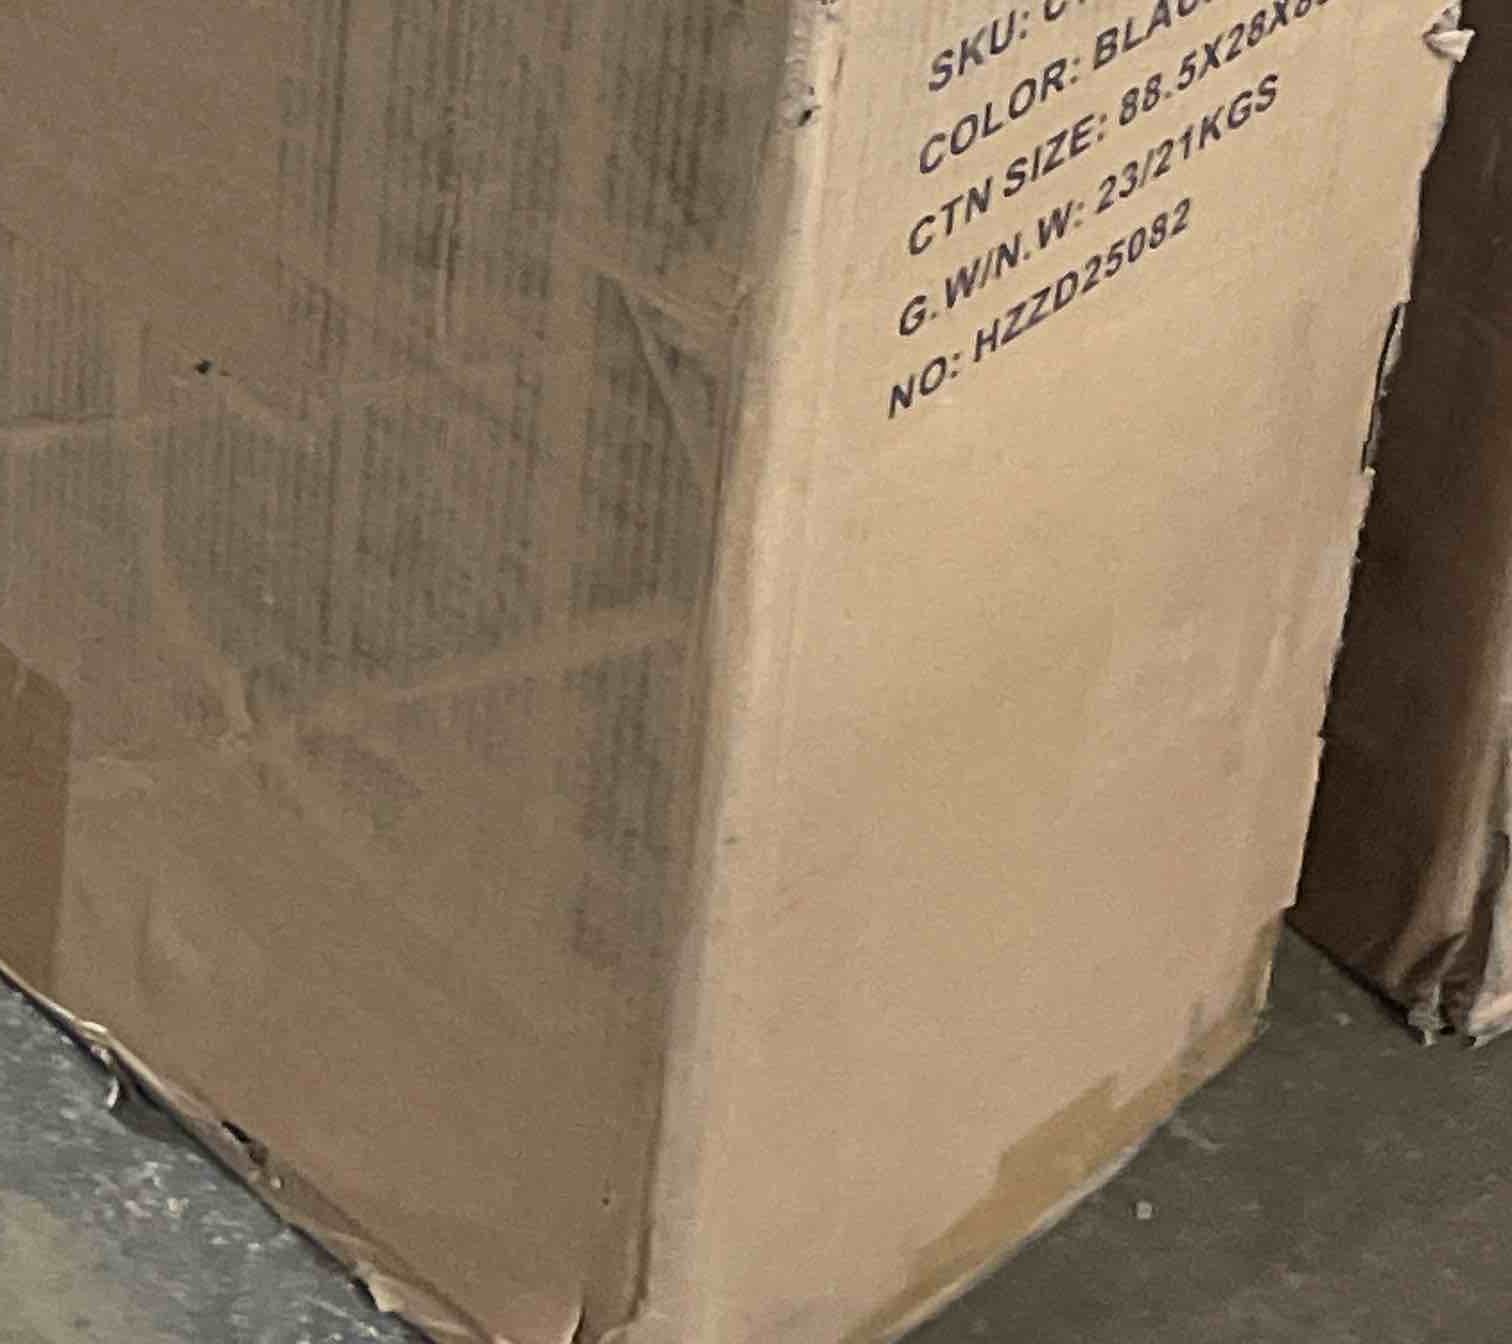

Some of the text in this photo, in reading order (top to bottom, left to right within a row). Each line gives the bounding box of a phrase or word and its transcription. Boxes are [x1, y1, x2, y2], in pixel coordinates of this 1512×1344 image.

[919, 57, 1081, 174] COLOR:
[928, 10, 1031, 93] SKU:
[909, 176, 993, 256] CTN
[1003, 112, 1108, 198] SIZE:
[1096, 73, 1279, 215] 23/21KGS
[887, 197, 1191, 419] NO: HZZD25082
